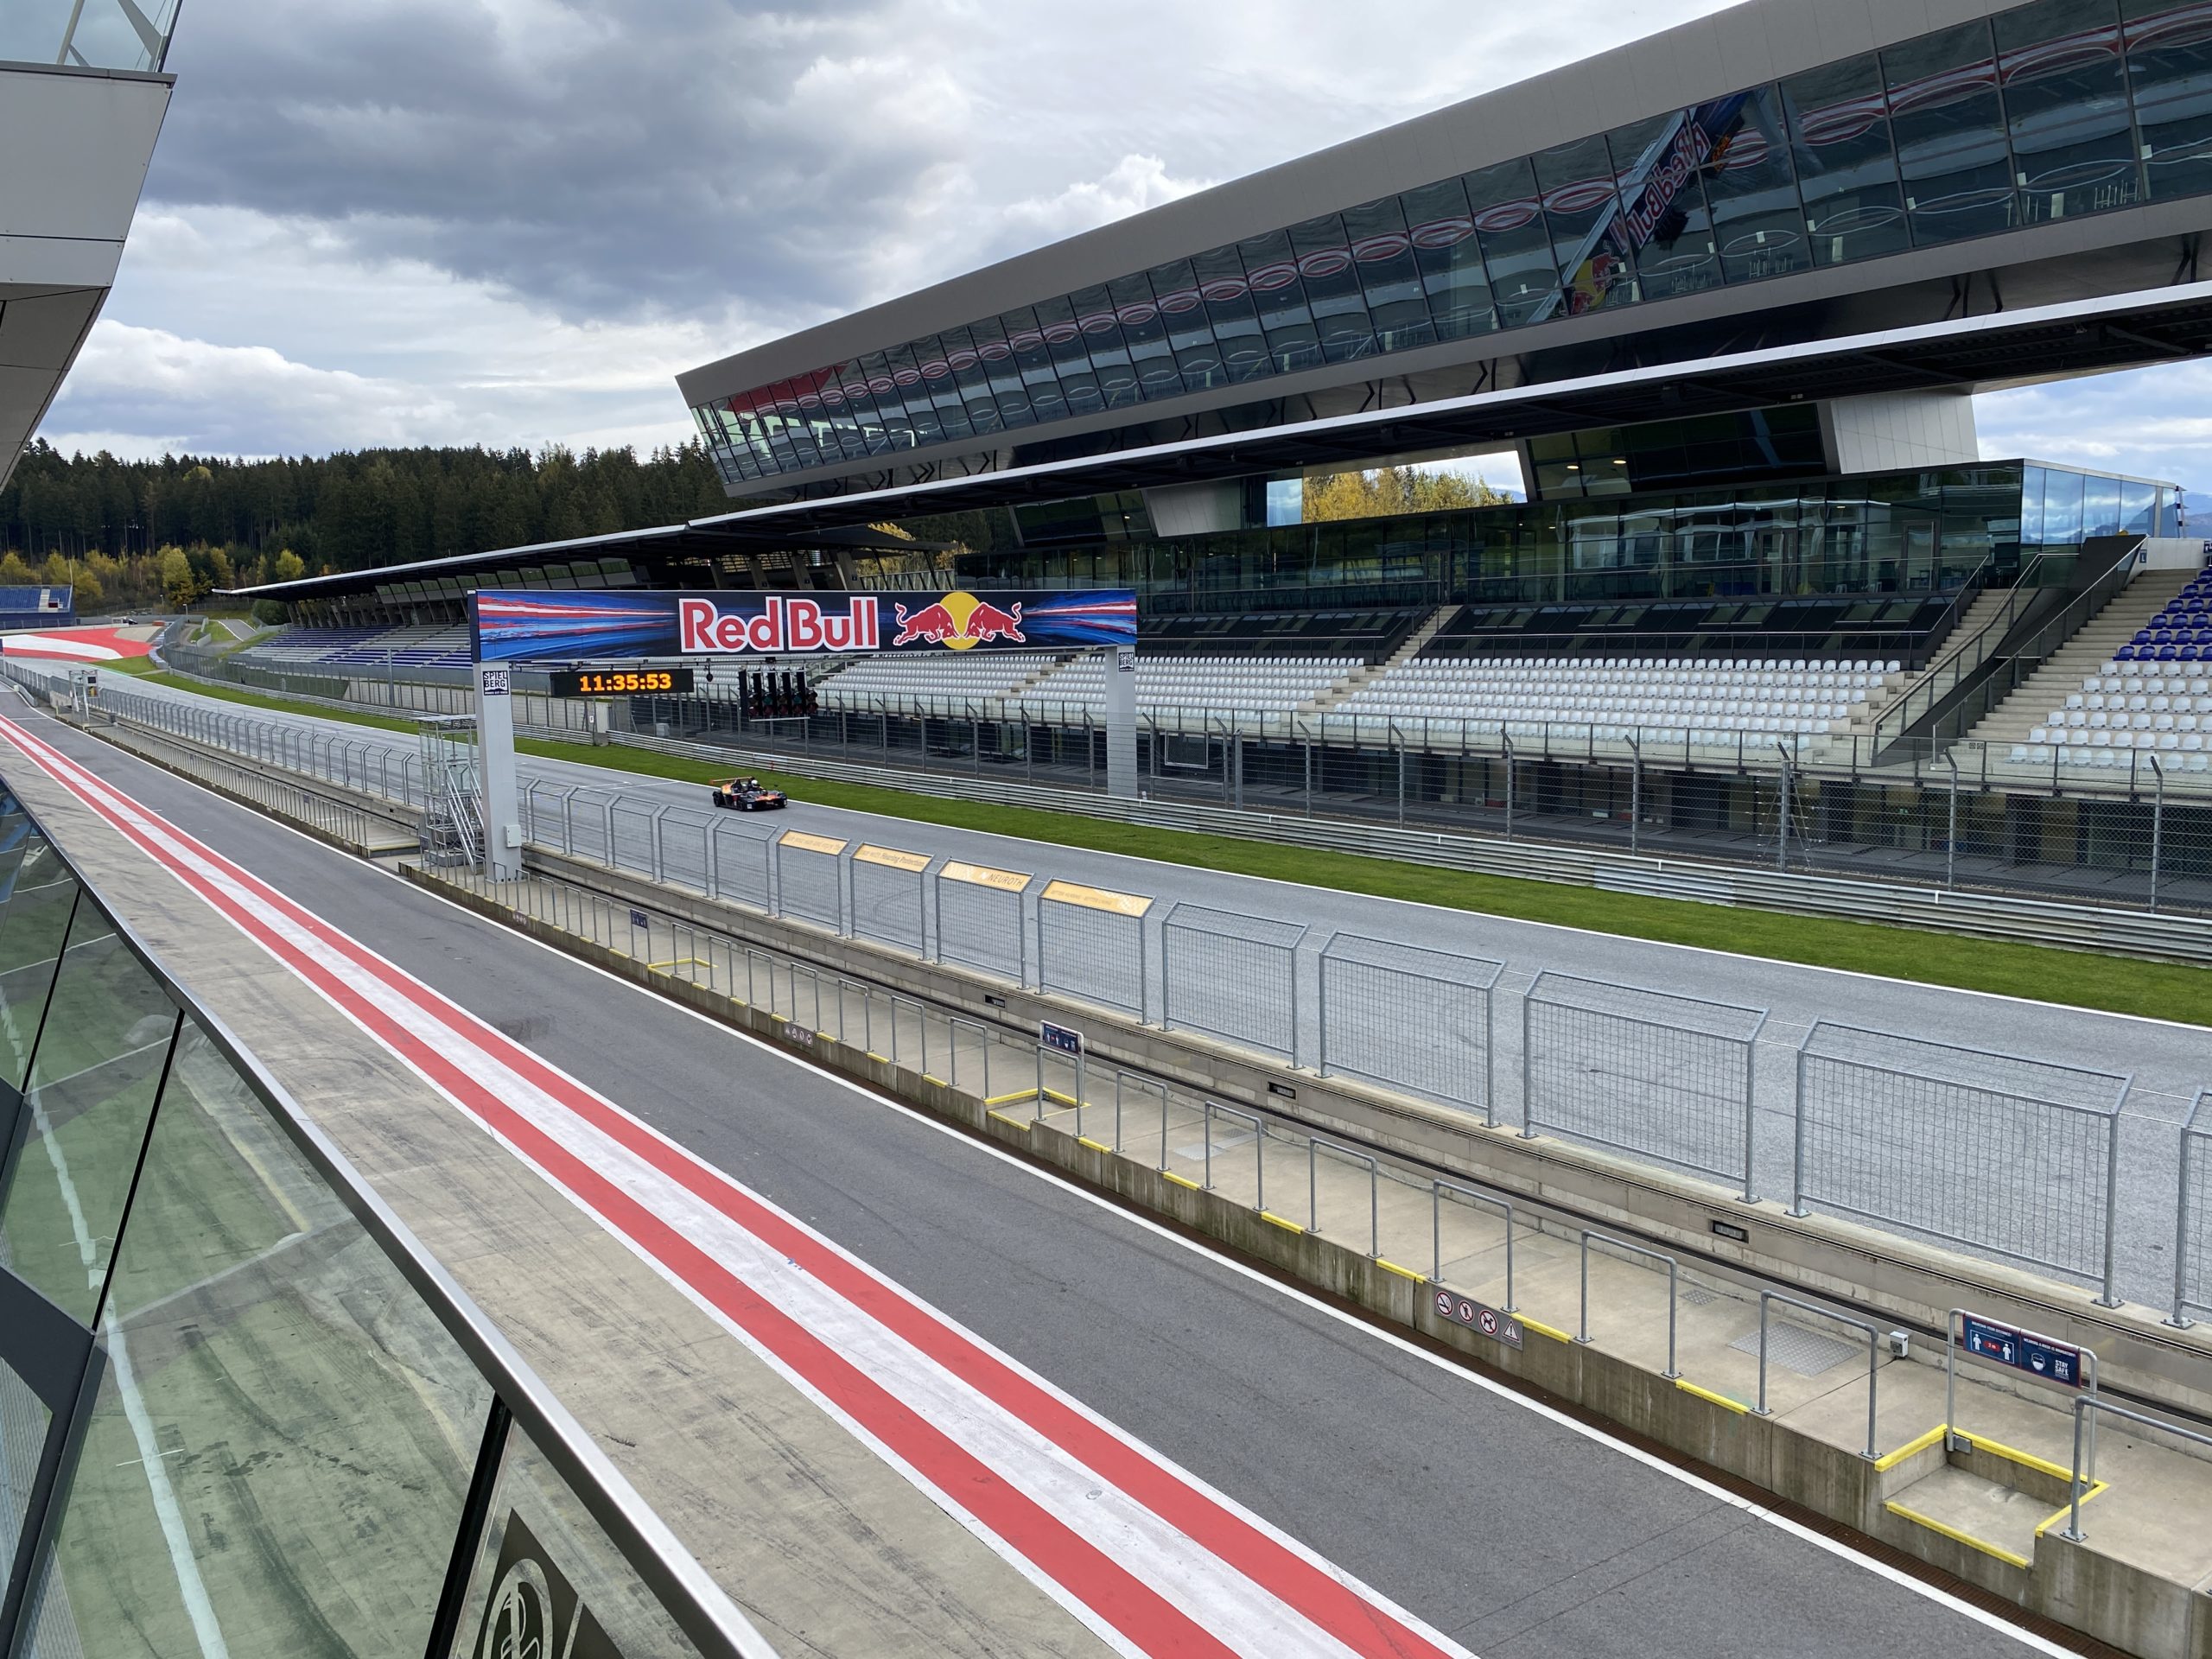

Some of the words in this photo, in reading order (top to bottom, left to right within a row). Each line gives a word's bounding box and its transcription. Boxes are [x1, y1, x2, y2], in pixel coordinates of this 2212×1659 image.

[679, 596, 784, 652] Red
[786, 596, 880, 651] Bull
[483, 671, 508, 680] SPIEL
[484, 679, 505, 688] BERG
[580, 673, 671, 691] 11:35:53
[987, 873, 1024, 887] NEUROTH
[2055, 1359, 2069, 1369] STAY
[2055, 1365, 2069, 1376] SAFE
